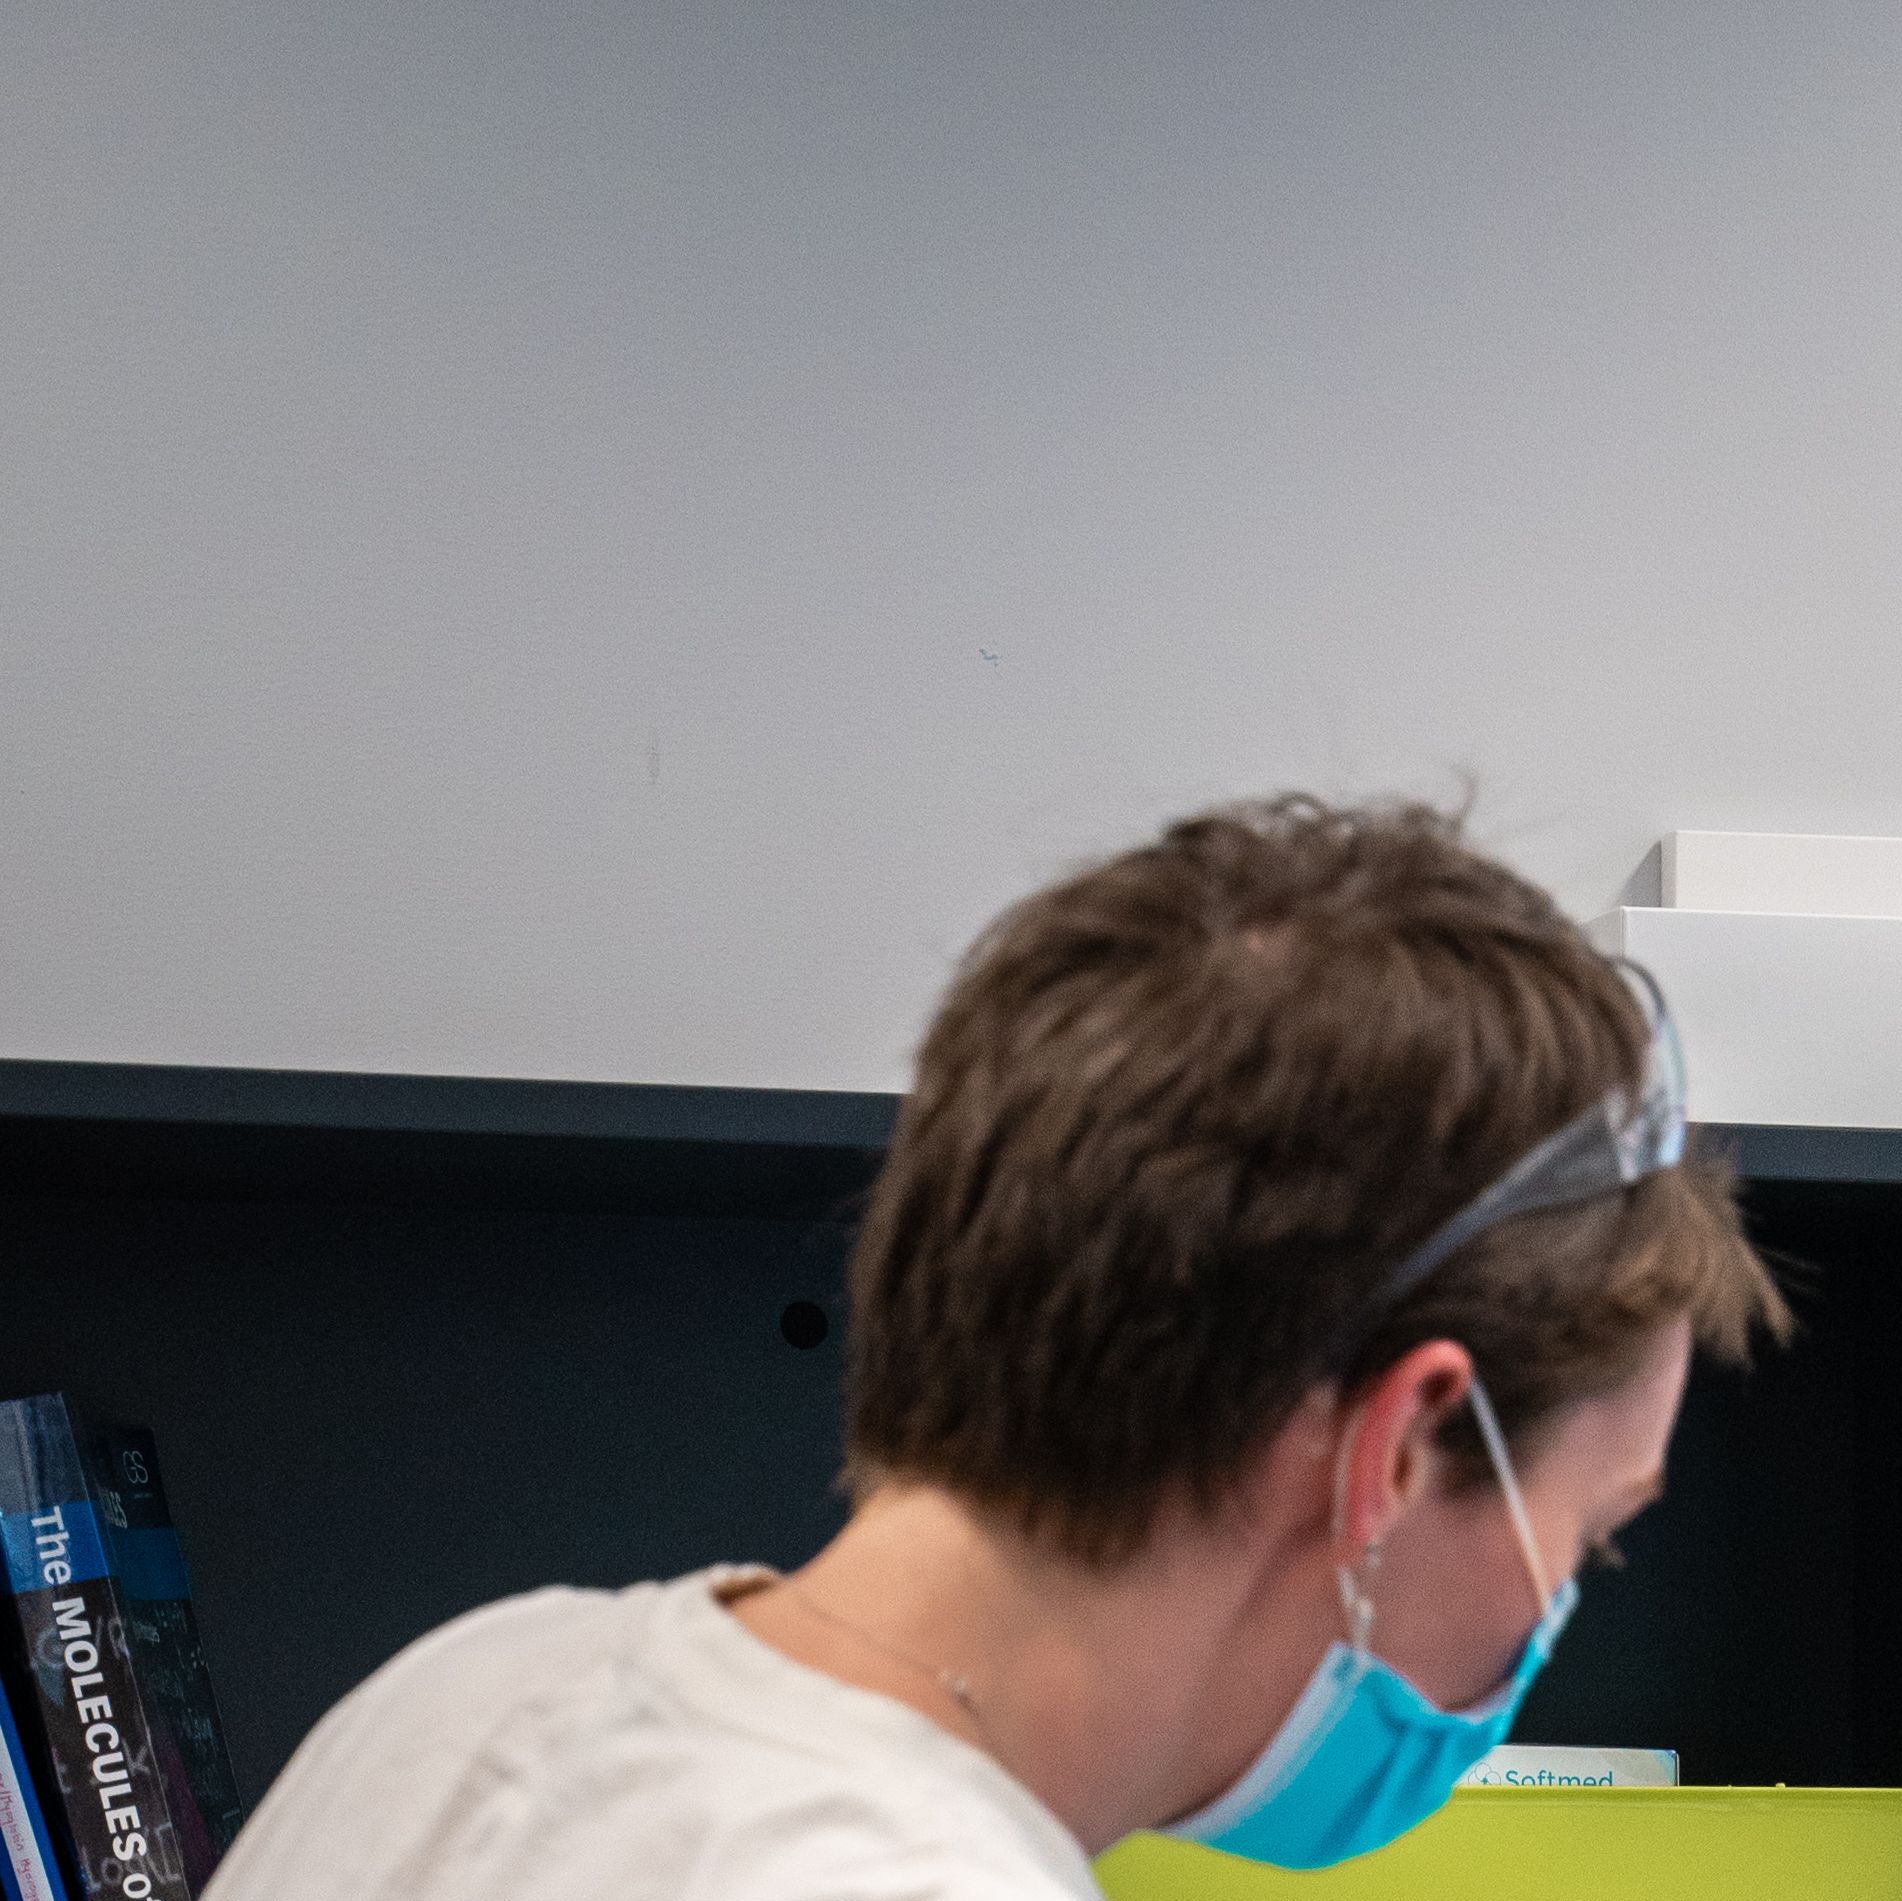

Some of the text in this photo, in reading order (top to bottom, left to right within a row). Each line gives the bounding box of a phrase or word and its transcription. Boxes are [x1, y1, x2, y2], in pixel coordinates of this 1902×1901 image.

[31, 1505, 72, 1585] The
[51, 1596, 147, 1862] MOLECULES
[1505, 1768, 1615, 1787] Softmed
